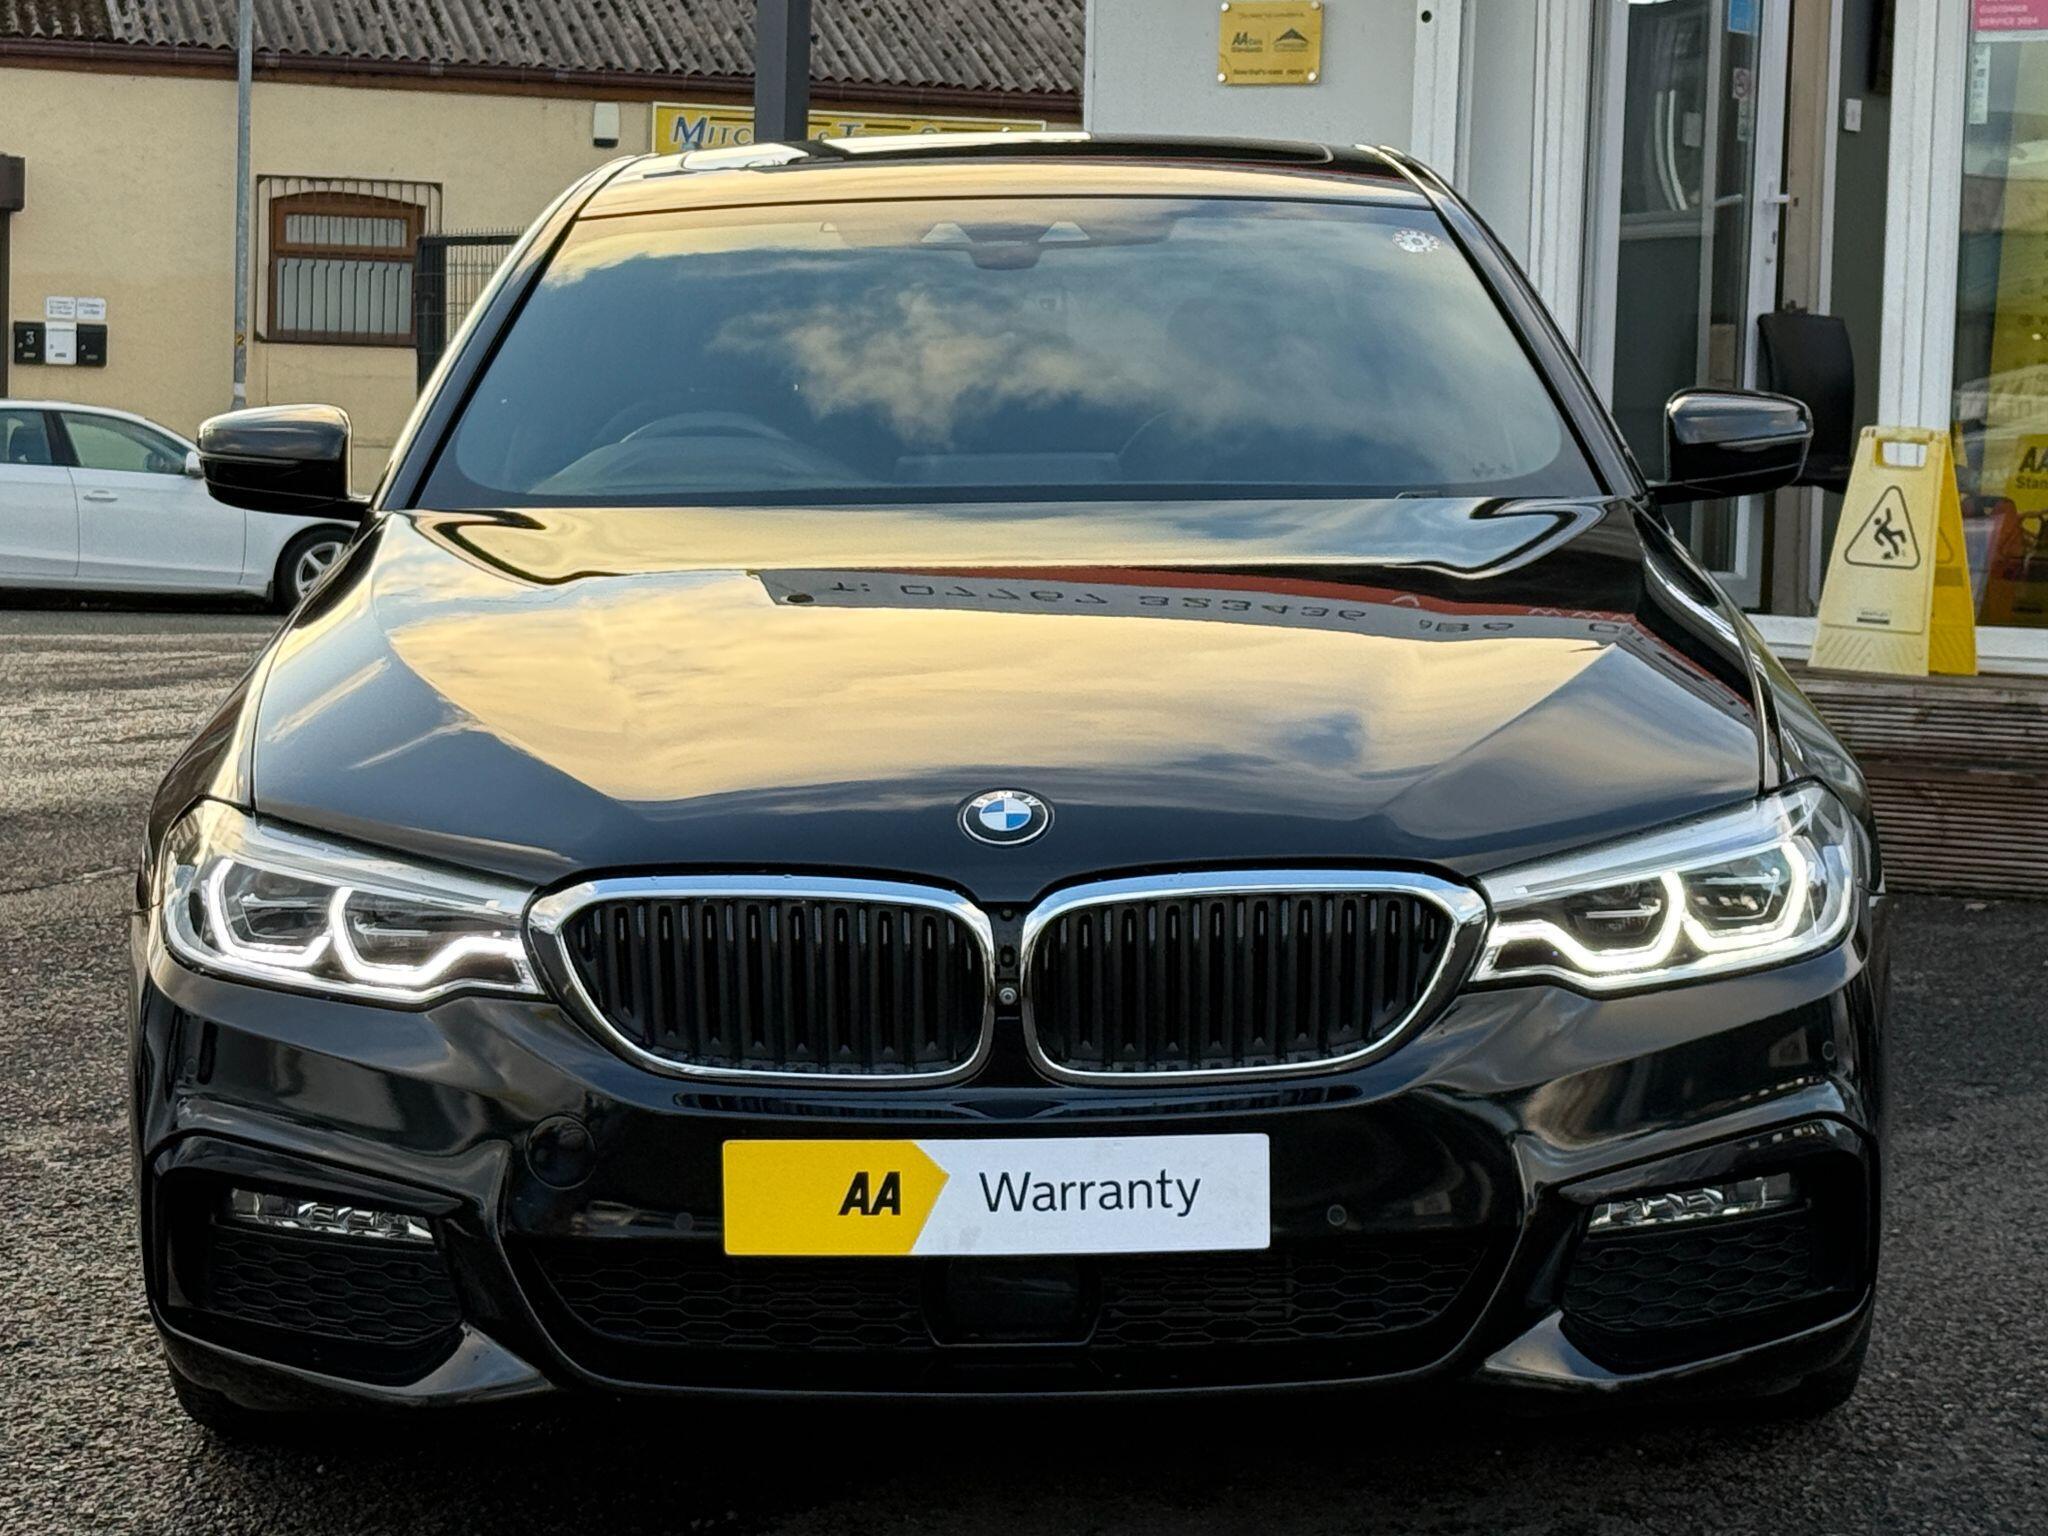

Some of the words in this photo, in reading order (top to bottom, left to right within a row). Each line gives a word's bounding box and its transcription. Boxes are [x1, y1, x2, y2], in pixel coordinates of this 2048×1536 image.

[25, 330, 36, 346] 3
[838, 1171, 902, 1216] AA
[979, 1169, 1201, 1217] Warranty
